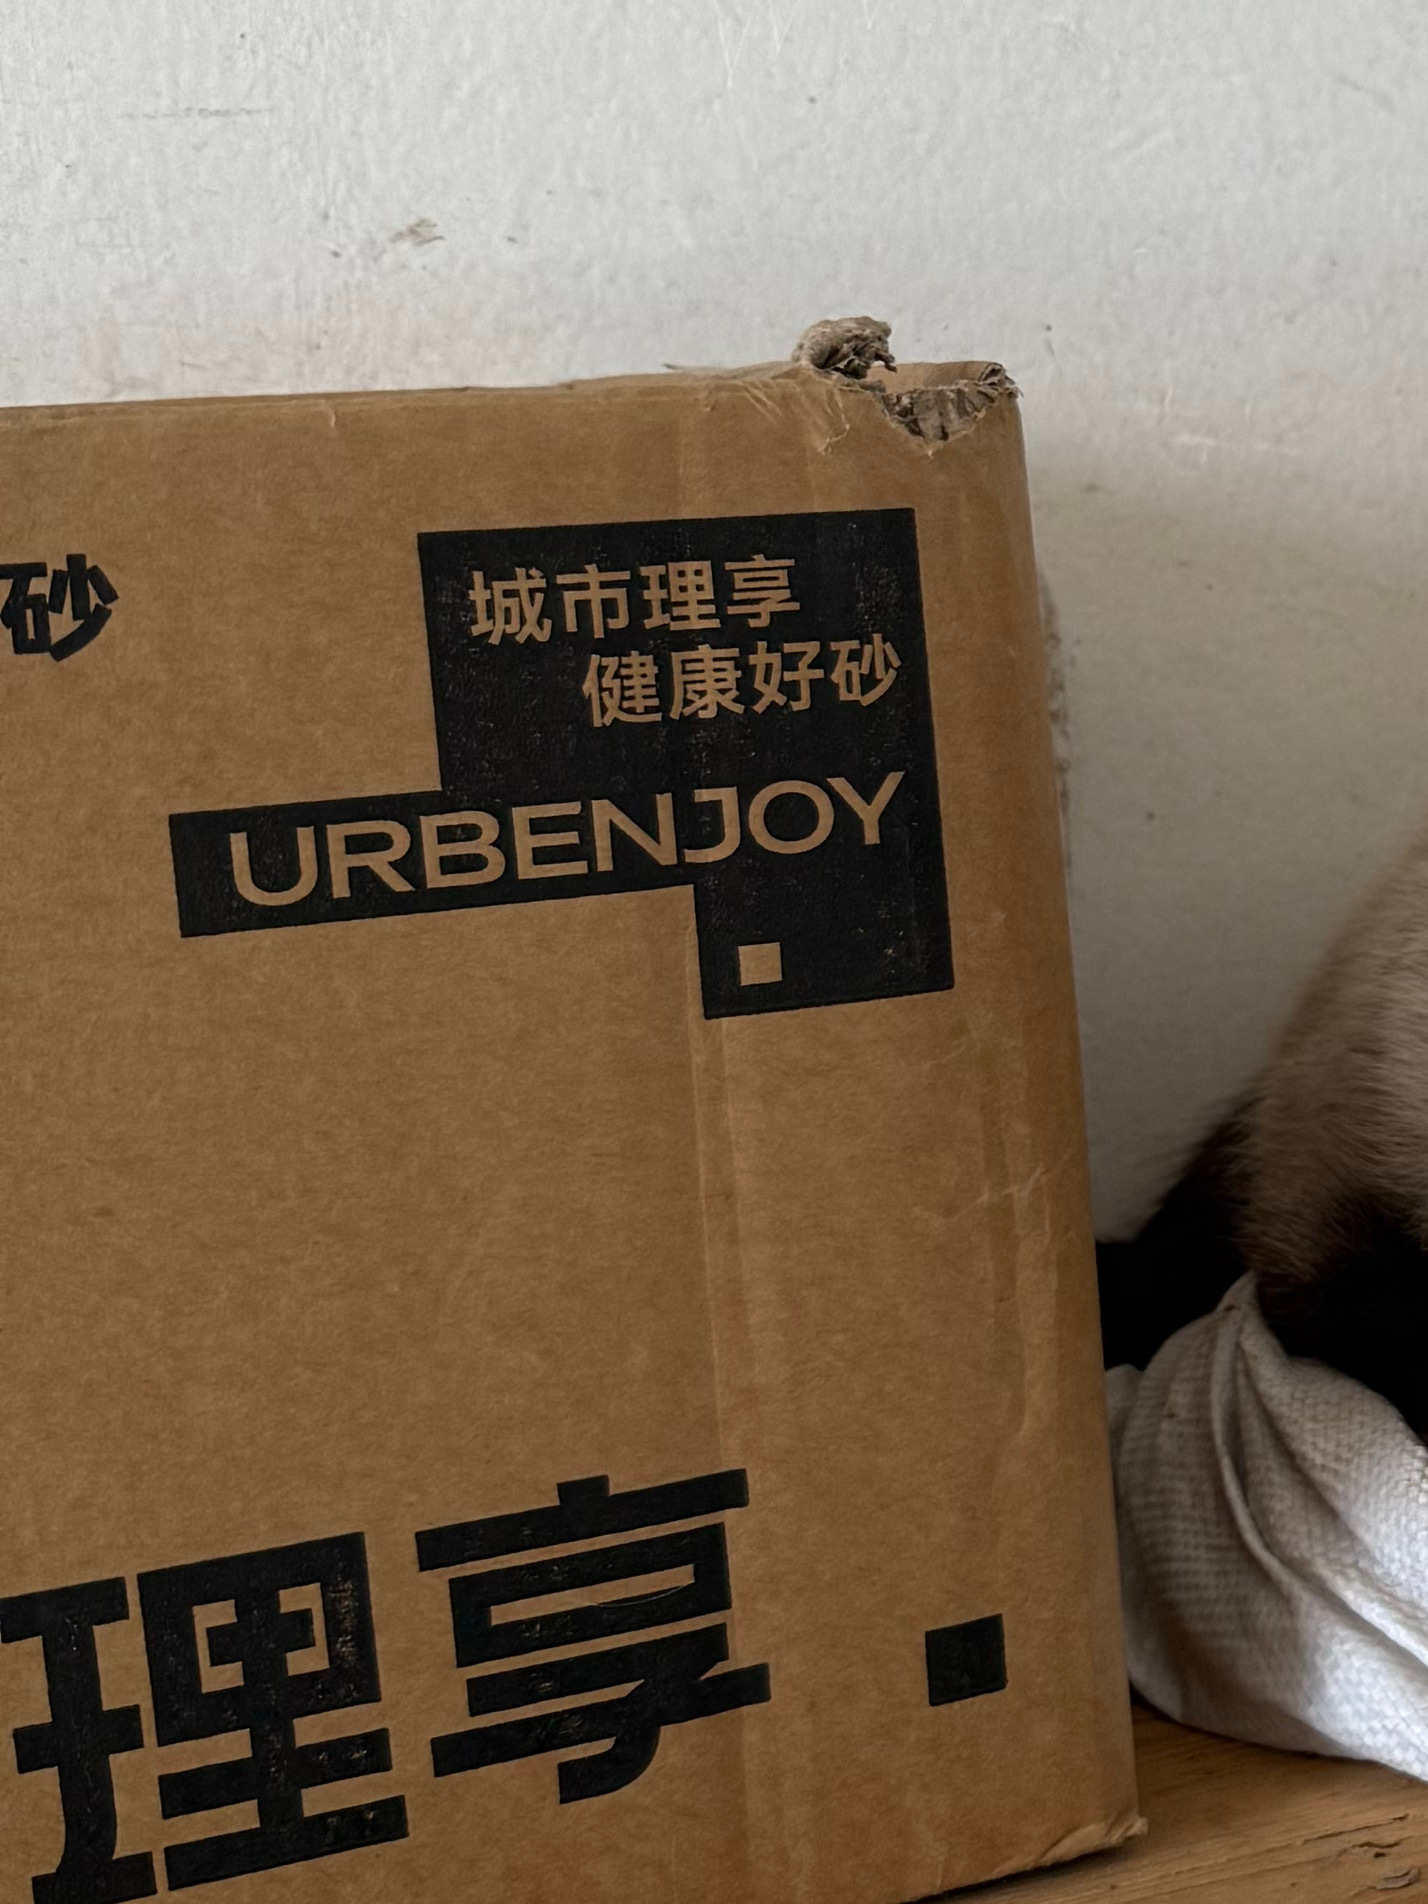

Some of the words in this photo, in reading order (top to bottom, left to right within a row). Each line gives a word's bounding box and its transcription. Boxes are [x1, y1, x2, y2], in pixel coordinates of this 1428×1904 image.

[0, 554, 119, 662] 砂
[468, 554, 801, 645] 城市理享
[582, 634, 902, 728] 健康好砂
[229, 771, 905, 907] URBENJOY
